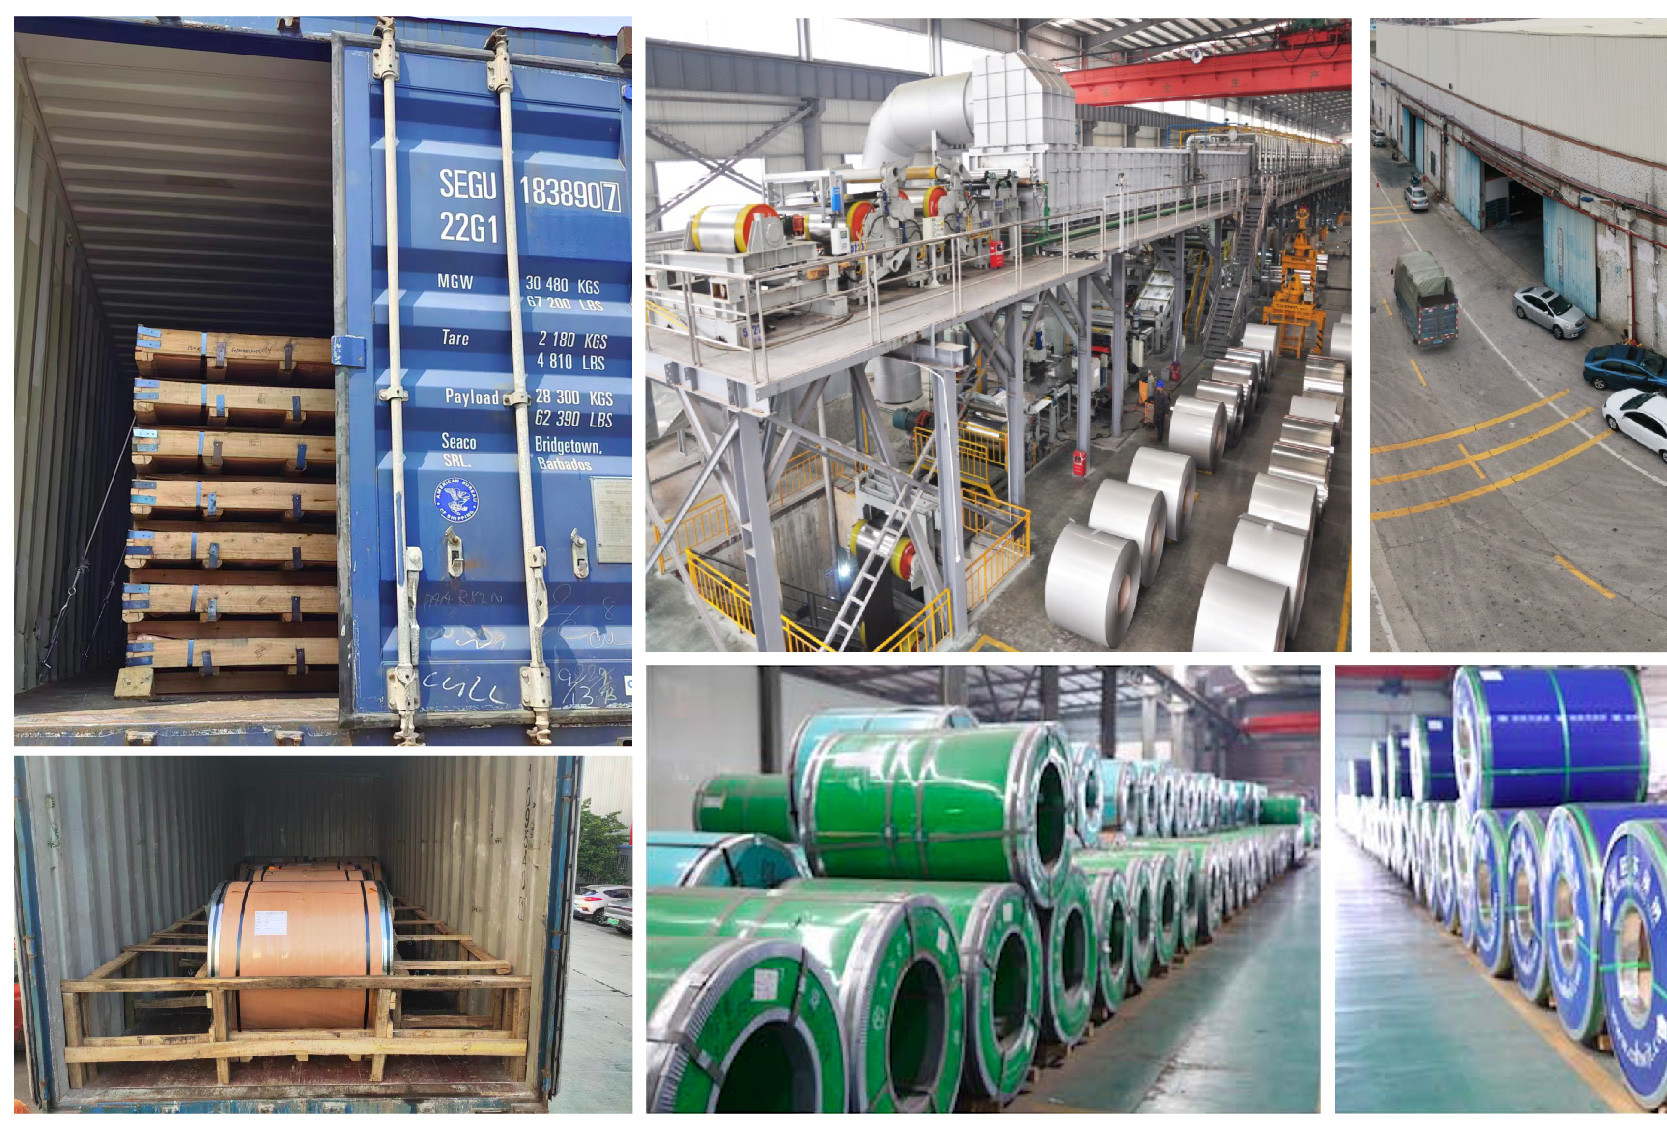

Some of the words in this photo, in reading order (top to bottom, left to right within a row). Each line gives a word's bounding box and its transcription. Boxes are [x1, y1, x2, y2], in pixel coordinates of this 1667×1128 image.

[439, 168, 497, 199] SEGU
[520, 176, 622, 213] 1838907
[440, 211, 498, 244] 22G1
[437, 273, 474, 290] MGW
[525, 275, 542, 290] 30
[545, 276, 569, 293] 480
[577, 279, 600, 295] KGS
[526, 295, 542, 308] 67
[546, 297, 571, 310] 200
[578, 299, 604, 312] LBS
[442, 329, 469, 346] Tare
[539, 330, 546, 346] 2
[553, 331, 576, 348] 180
[584, 333, 608, 349] KGS
[537, 352, 544, 368] 4
[549, 353, 573, 369] 810
[582, 354, 605, 371] LBS
[445, 387, 499, 408] Payload
[535, 388, 550, 404] 28
[556, 389, 580, 405] 300
[589, 390, 614, 407] KGS
[535, 410, 550, 426] 62
[556, 411, 580, 427] 390
[589, 412, 613, 428] LBS
[441, 432, 477, 450] Seaco
[535, 435, 602, 456] Bridgetown,
[443, 453, 472, 468] SRL.
[537, 457, 593, 471] Barbados
[435, 478, 460, 499] AMERICAN
[461, 481, 478, 503] BUREAU
[446, 510, 475, 521] SHIPPING
